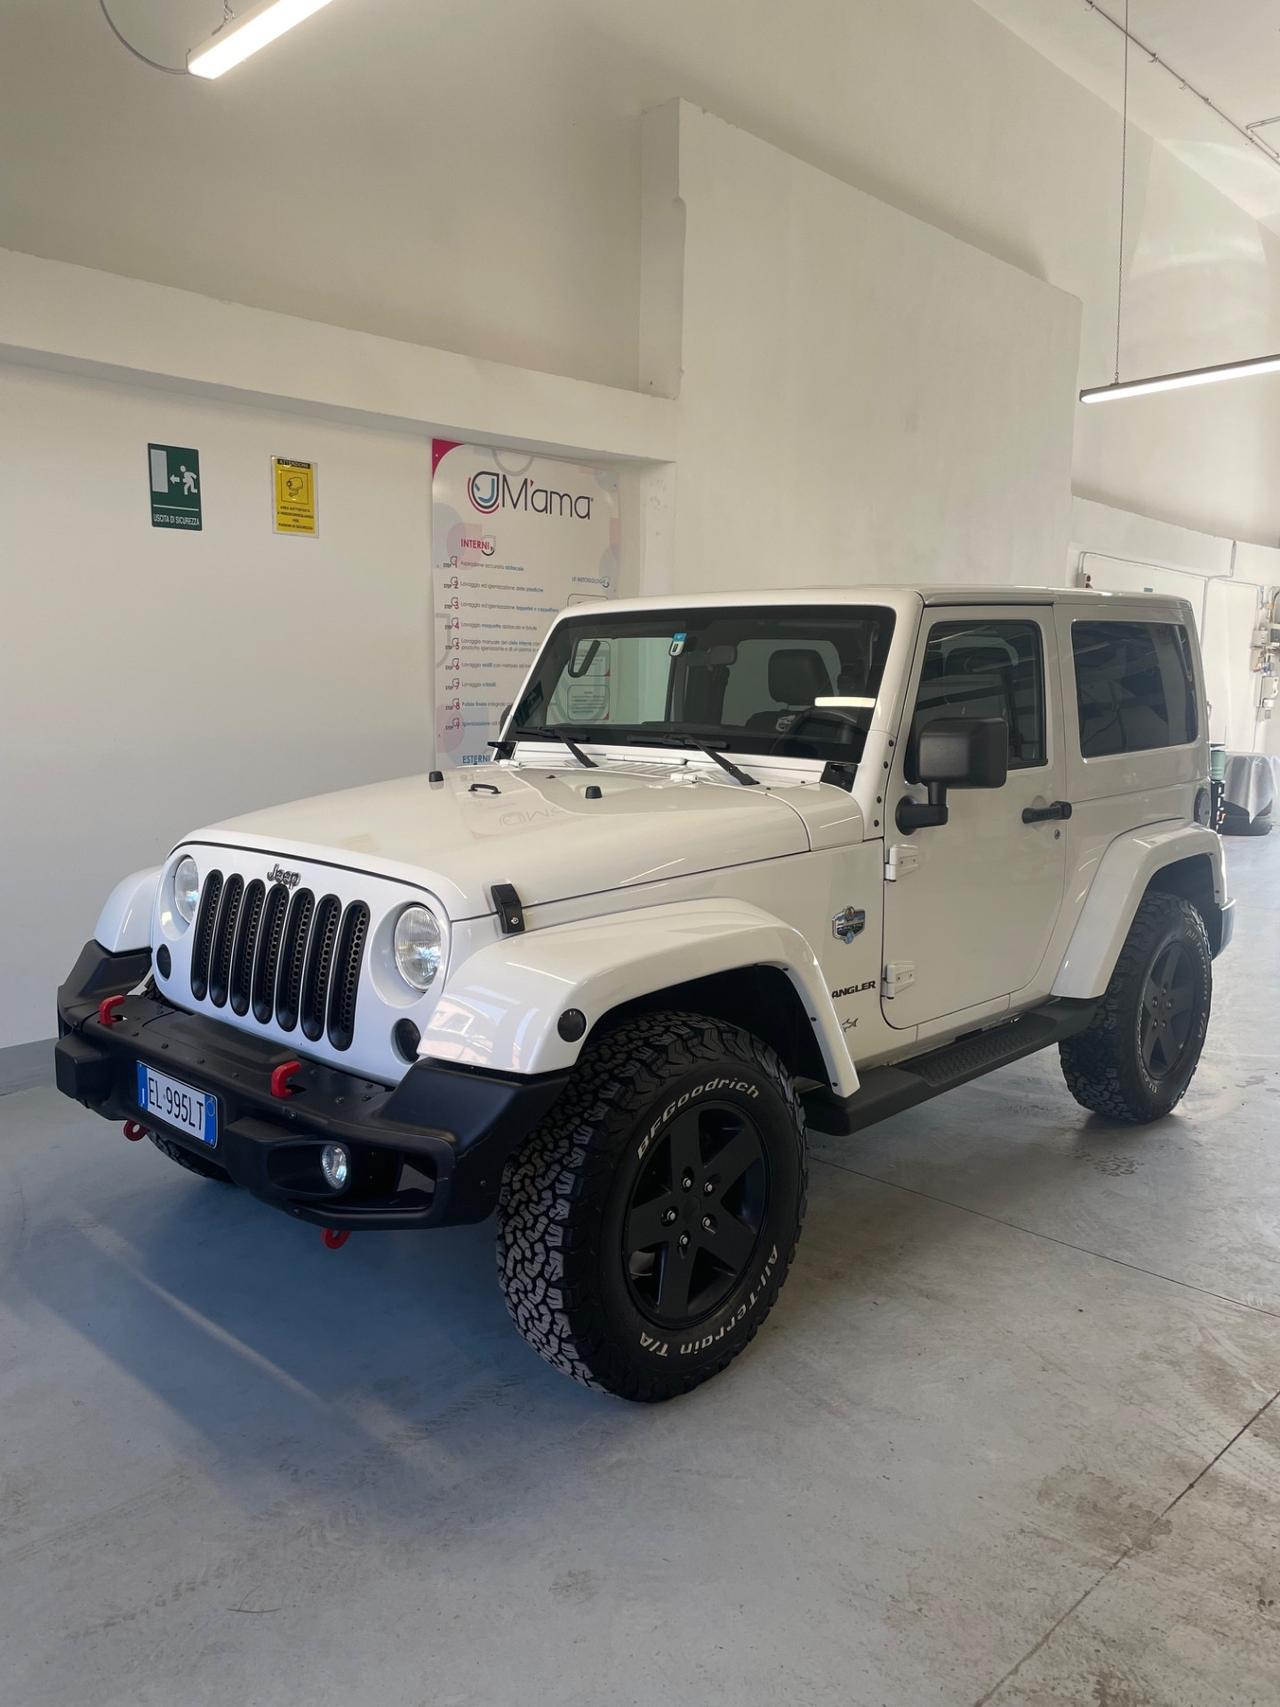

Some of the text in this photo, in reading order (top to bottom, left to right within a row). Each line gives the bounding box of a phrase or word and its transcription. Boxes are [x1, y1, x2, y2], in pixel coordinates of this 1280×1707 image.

[153, 513, 200, 526] USCITA DI SICUREZZA
[460, 539, 490, 549] INTERNI
[266, 863, 301, 890] Jeep
[831, 980, 876, 999] ANGLER
[148, 1077, 204, 1131] EL 995LT
[637, 1077, 760, 1160] BFGoodrich
[639, 1243, 778, 1357] All-Terrain T/A
